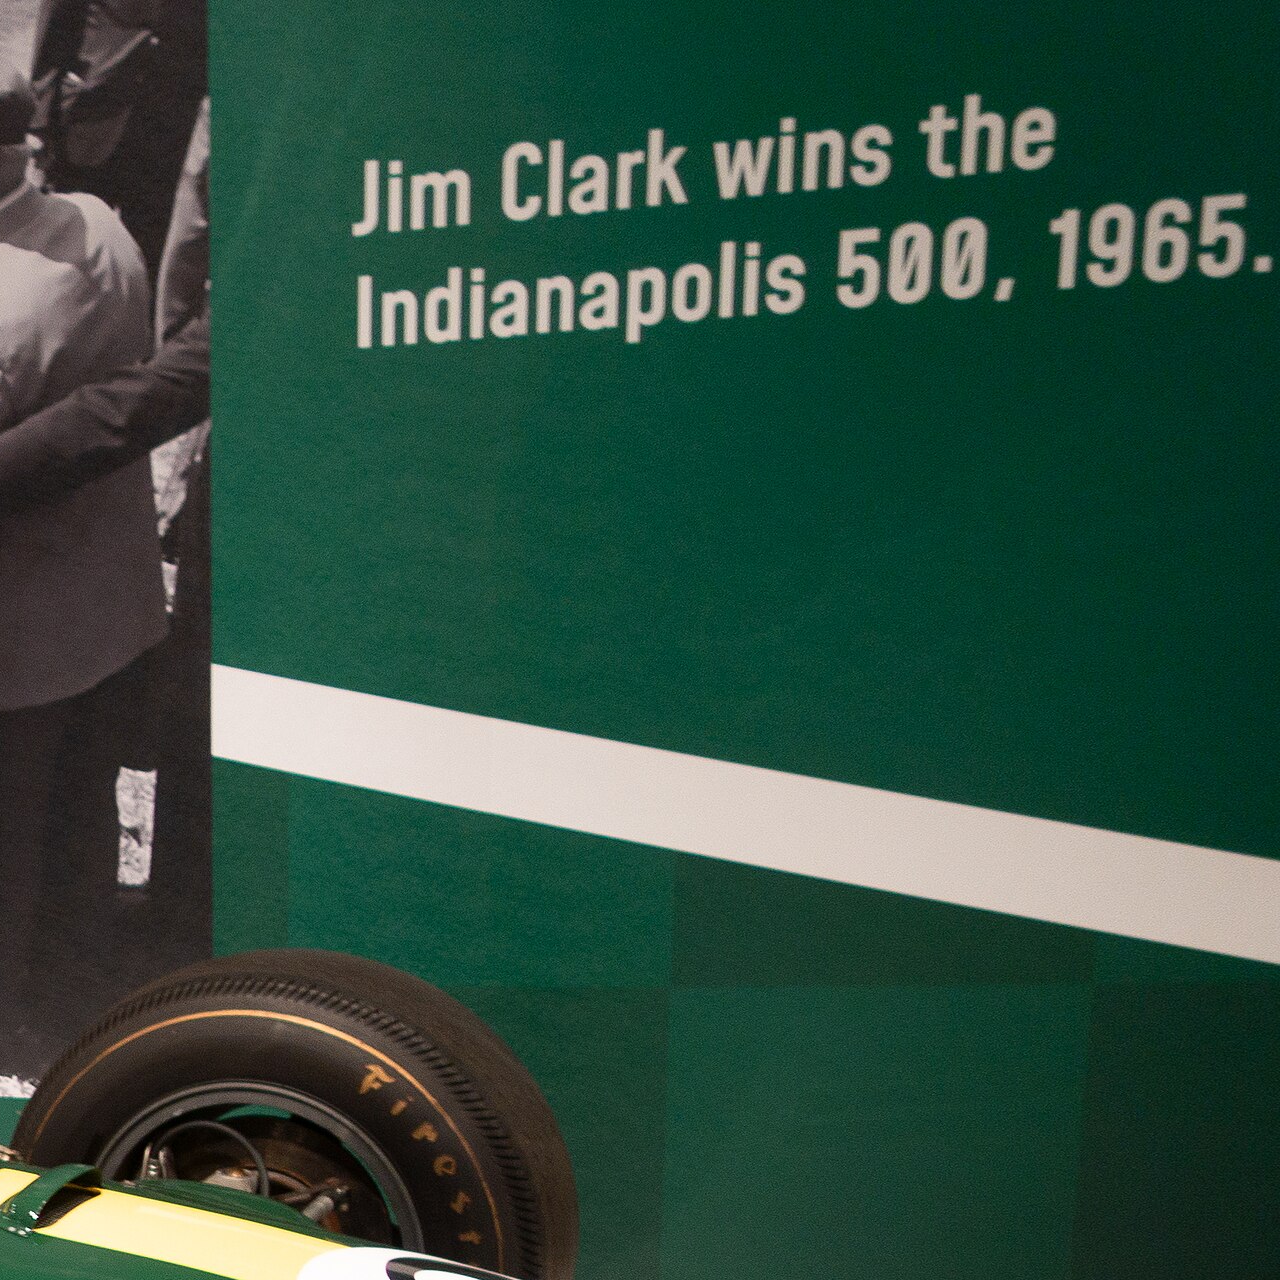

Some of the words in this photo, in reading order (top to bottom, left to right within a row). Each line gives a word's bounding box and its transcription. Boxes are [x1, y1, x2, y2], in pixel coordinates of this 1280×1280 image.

[352, 159, 472, 237] Jim
[501, 128, 688, 222] Clark
[713, 117, 893, 200] wins
[918, 94, 1057, 178] the
[356, 241, 807, 348] Indianapolis
[837, 217, 1016, 309] 500,
[1048, 193, 1274, 292] 1965.
[358, 1063, 482, 1247] Firest
